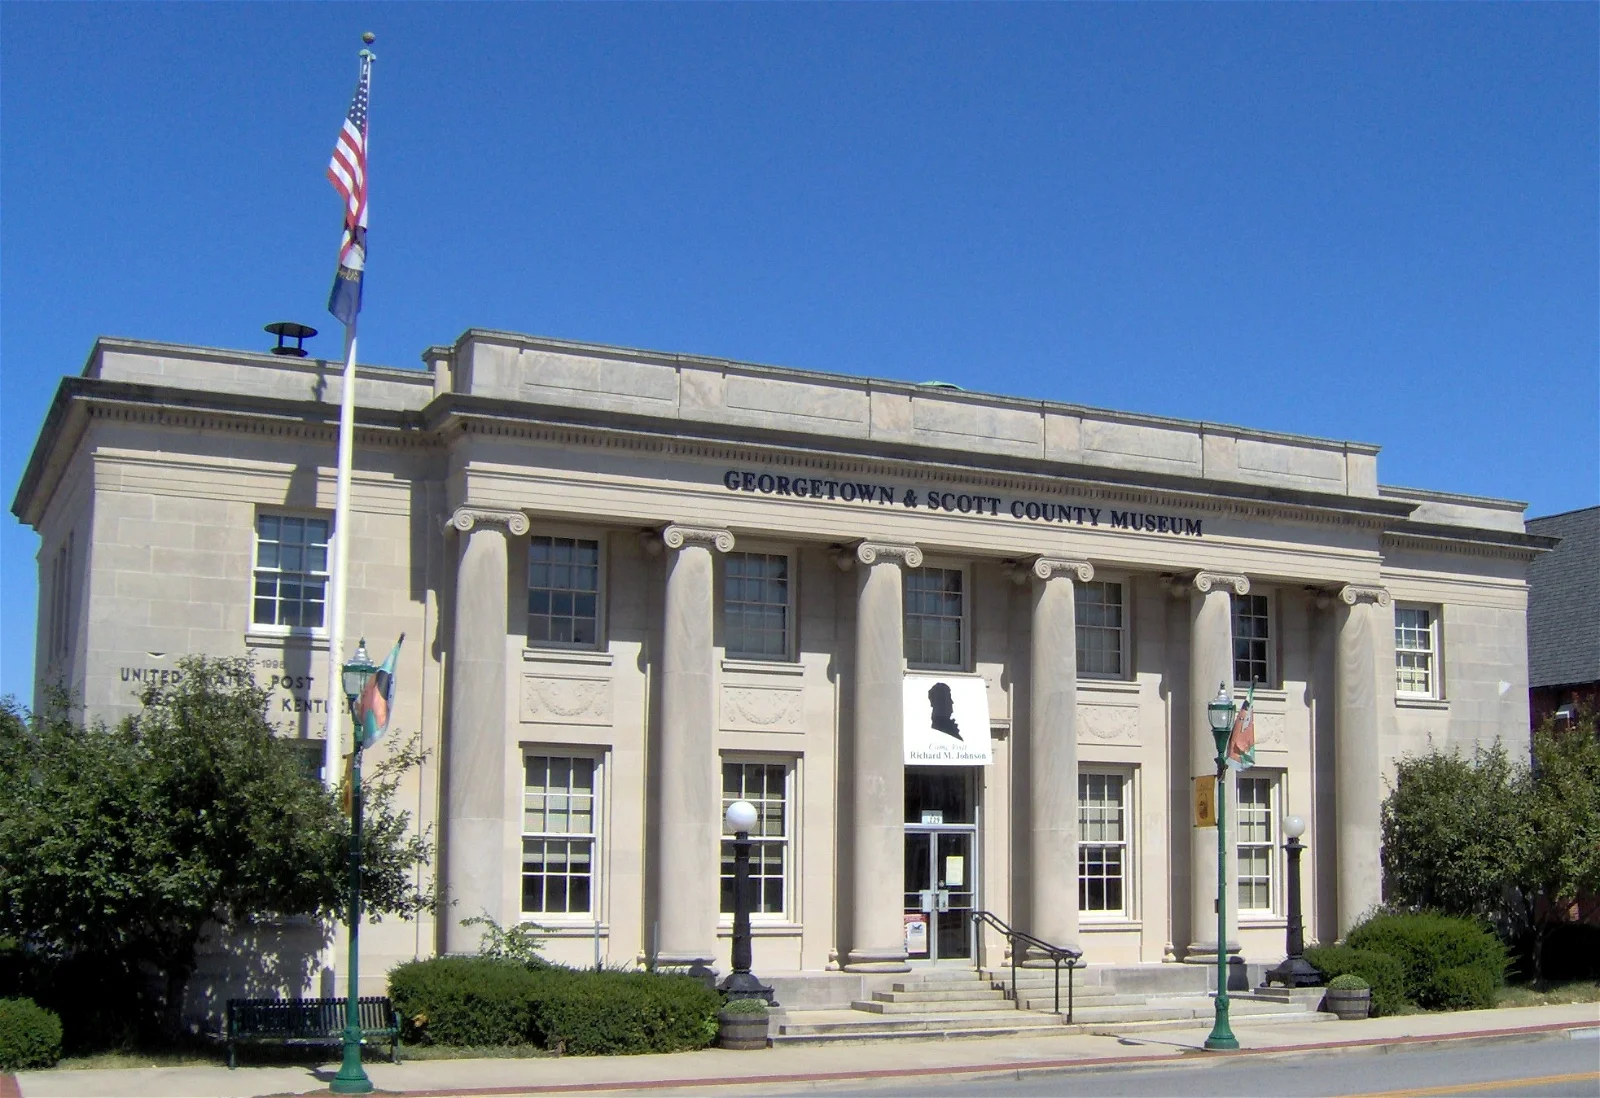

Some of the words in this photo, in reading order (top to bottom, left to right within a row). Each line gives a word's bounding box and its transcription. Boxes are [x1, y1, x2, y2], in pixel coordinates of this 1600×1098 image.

[724, 470, 895, 506] GEORGETOWN
[903, 488, 918, 509] &
[927, 491, 1001, 516] SCOTT
[1010, 500, 1102, 526] COUNTY
[1110, 510, 1203, 537] MUSEUM
[121, 667, 181, 685] UNITED
[271, 674, 314, 690] POST
[910, 751, 942, 760] Richard
[944, 751, 954, 760] M.
[956, 751, 987, 760] Johnson
